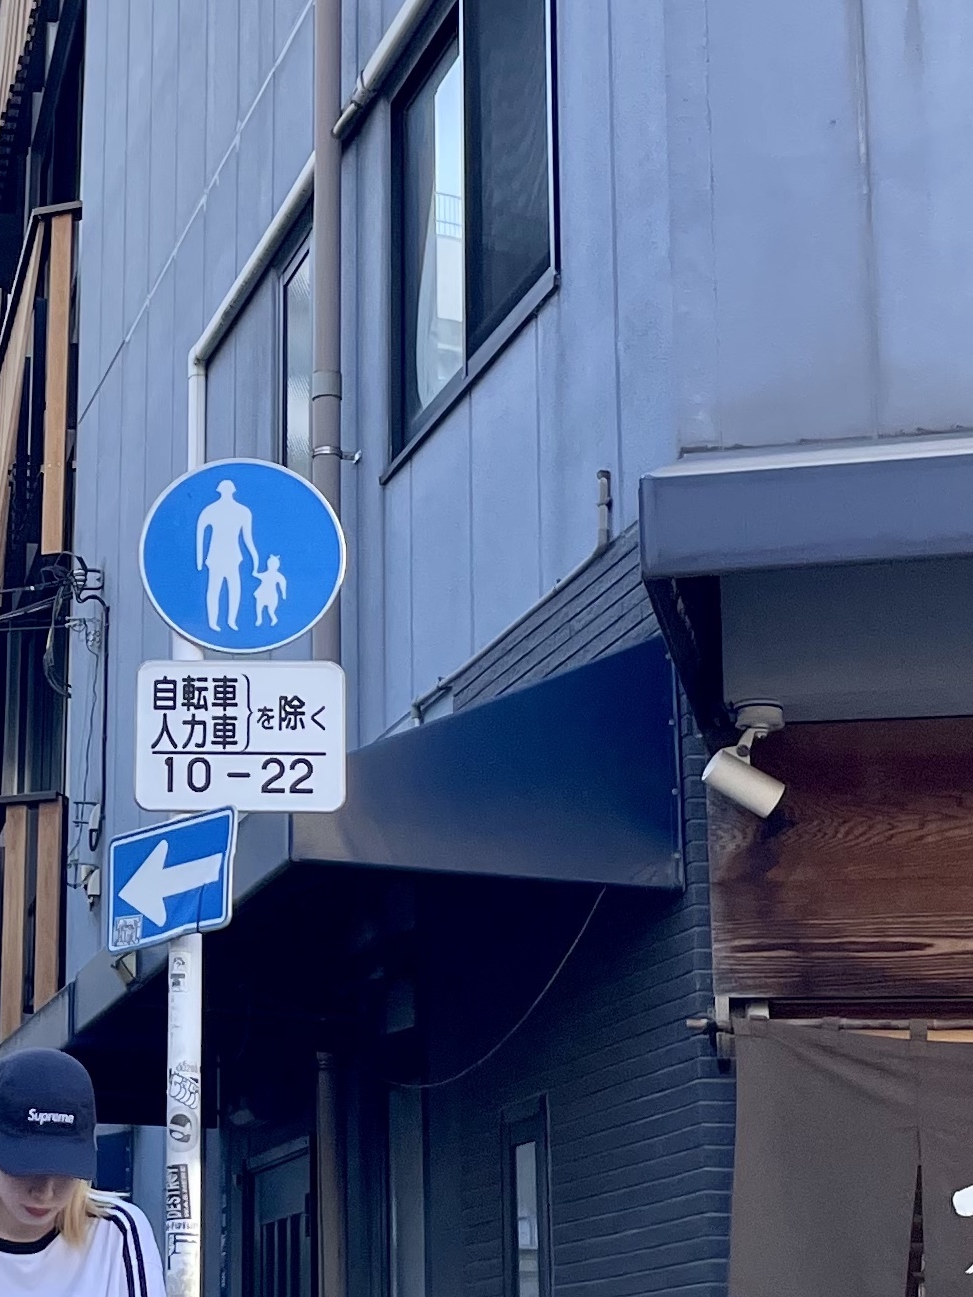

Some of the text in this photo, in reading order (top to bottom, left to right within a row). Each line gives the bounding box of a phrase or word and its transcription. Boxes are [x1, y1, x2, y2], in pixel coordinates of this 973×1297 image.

[153, 675, 239, 712] 自転車
[150, 712, 239, 750] 人力車
[256, 695, 326, 731] を除く
[27, 1107, 75, 1126] Supreme
